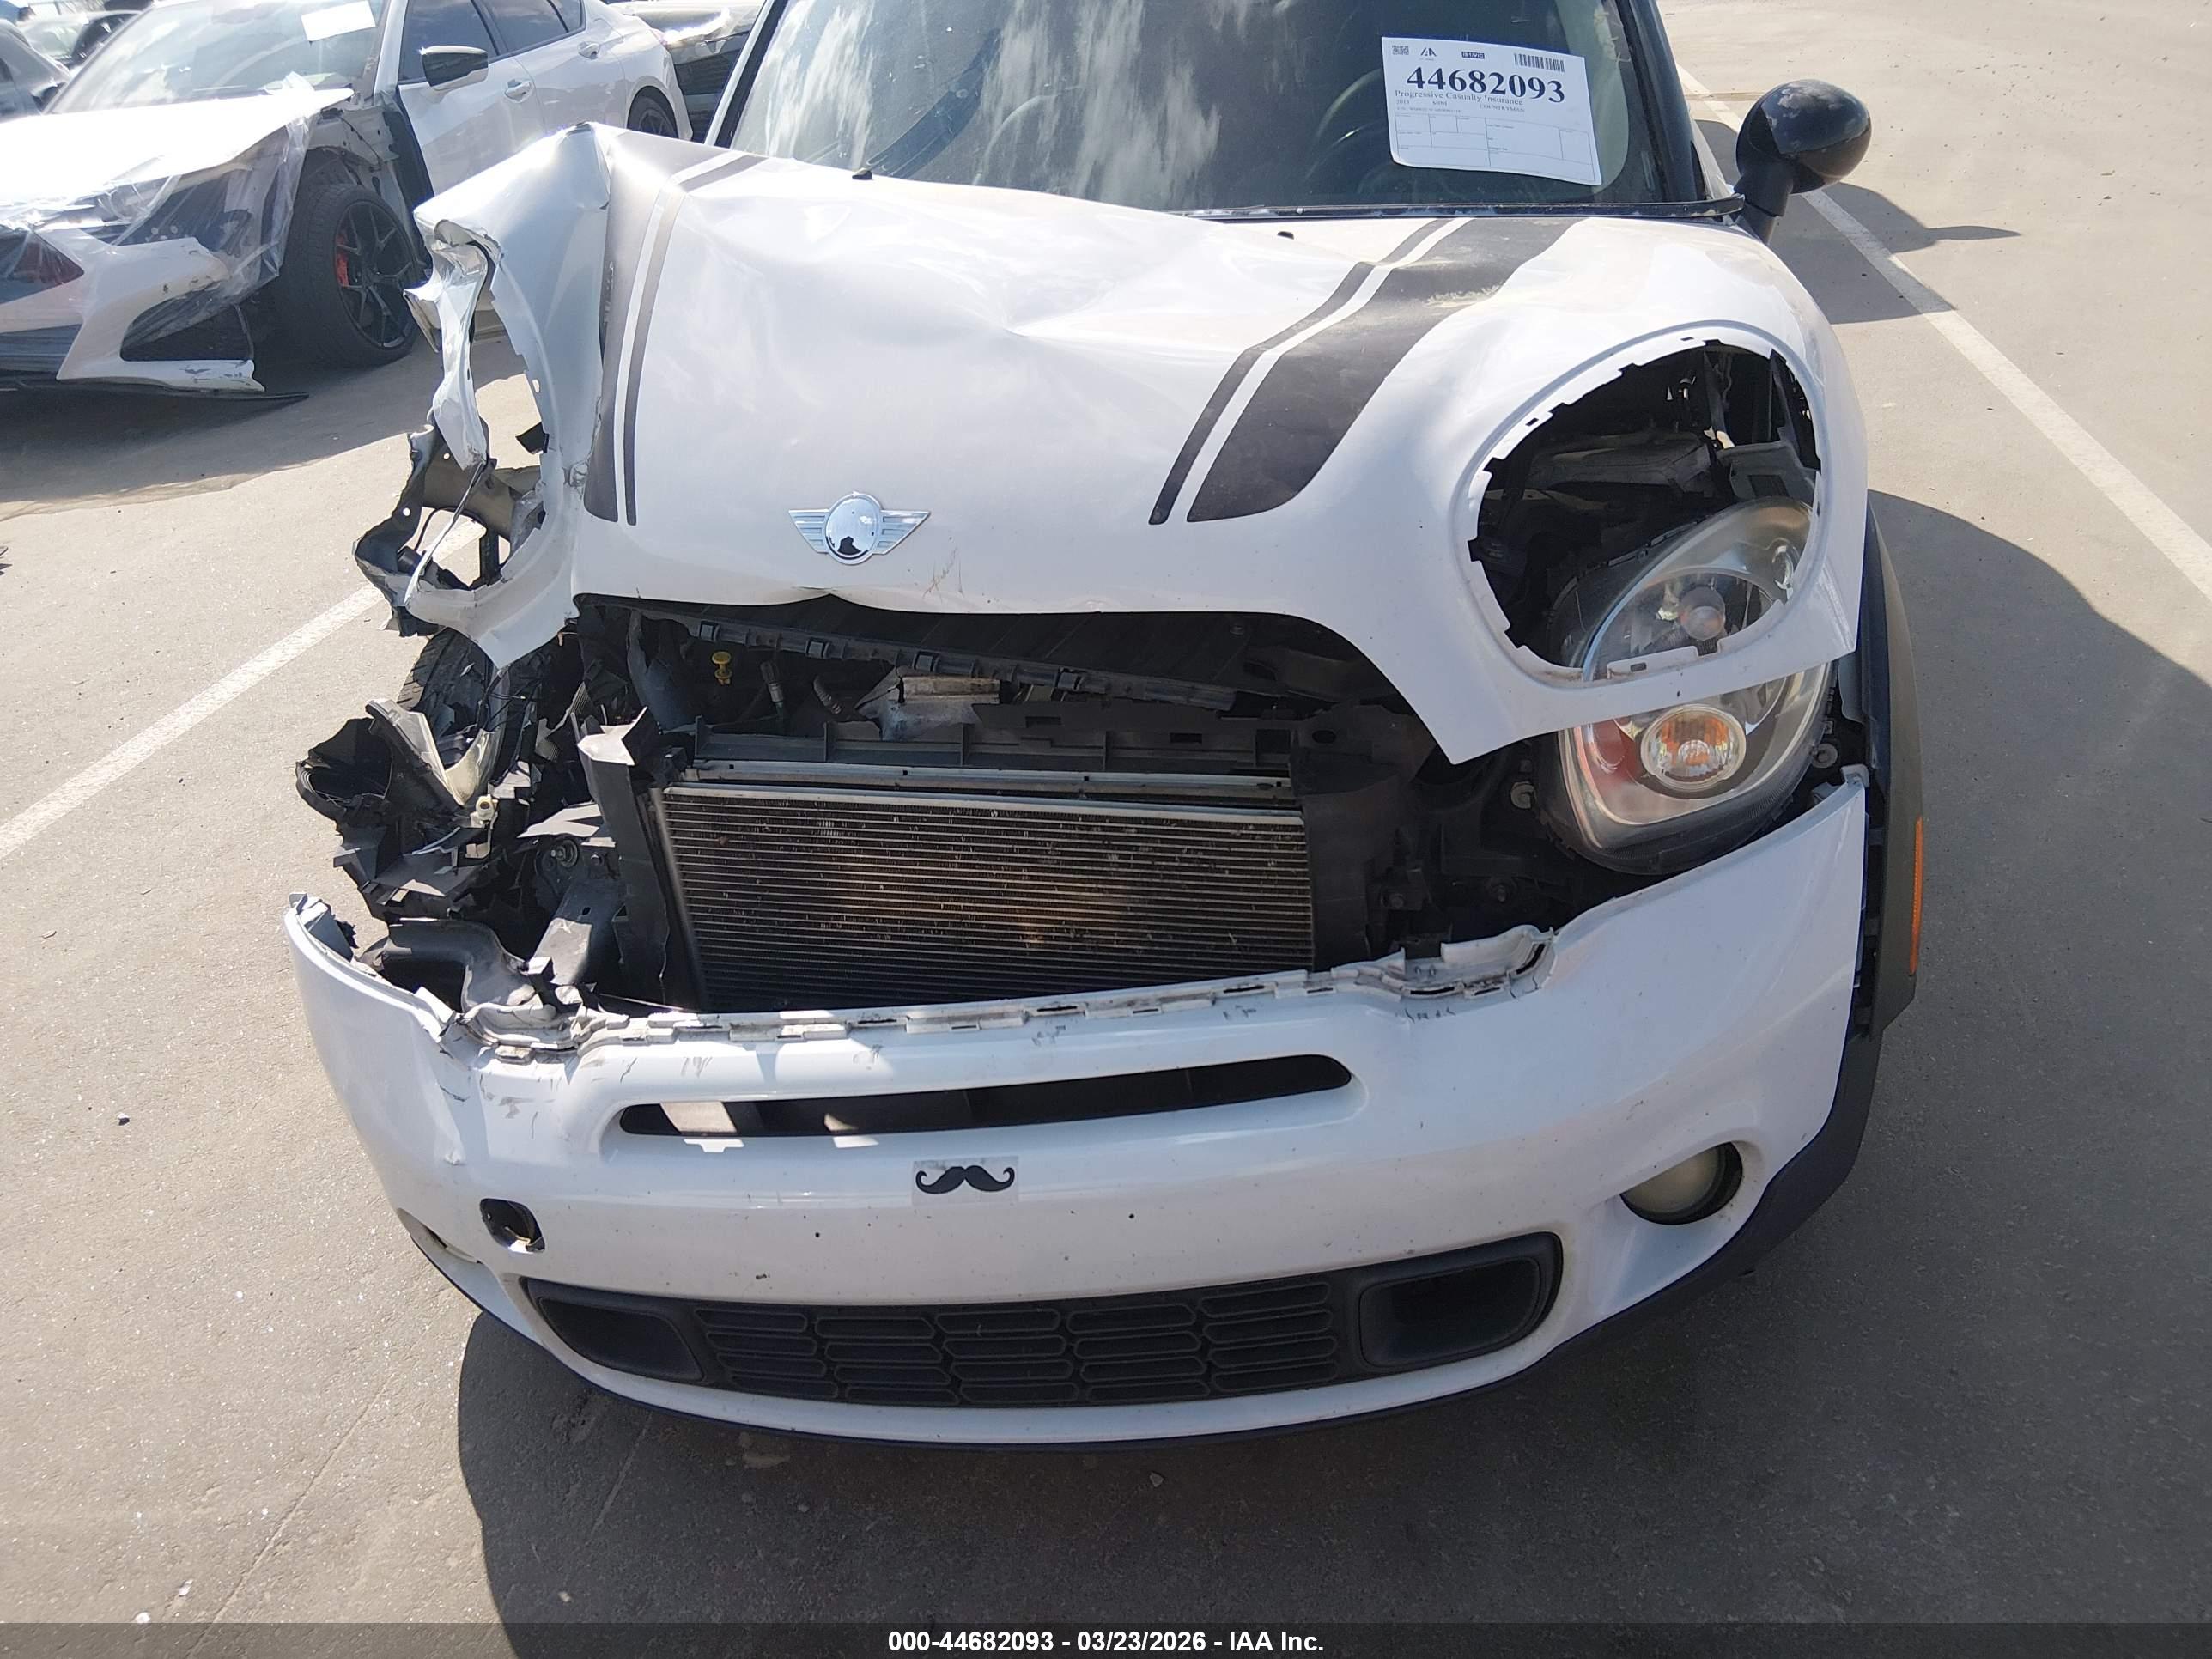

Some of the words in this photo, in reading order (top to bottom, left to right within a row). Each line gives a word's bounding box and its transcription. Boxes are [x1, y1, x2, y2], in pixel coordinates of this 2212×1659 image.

[1395, 89, 1443, 100] Progressive
[1446, 92, 1482, 102] Casualty
[1484, 95, 1523, 106] Insurance
[1407, 66, 1565, 103] 44682093
